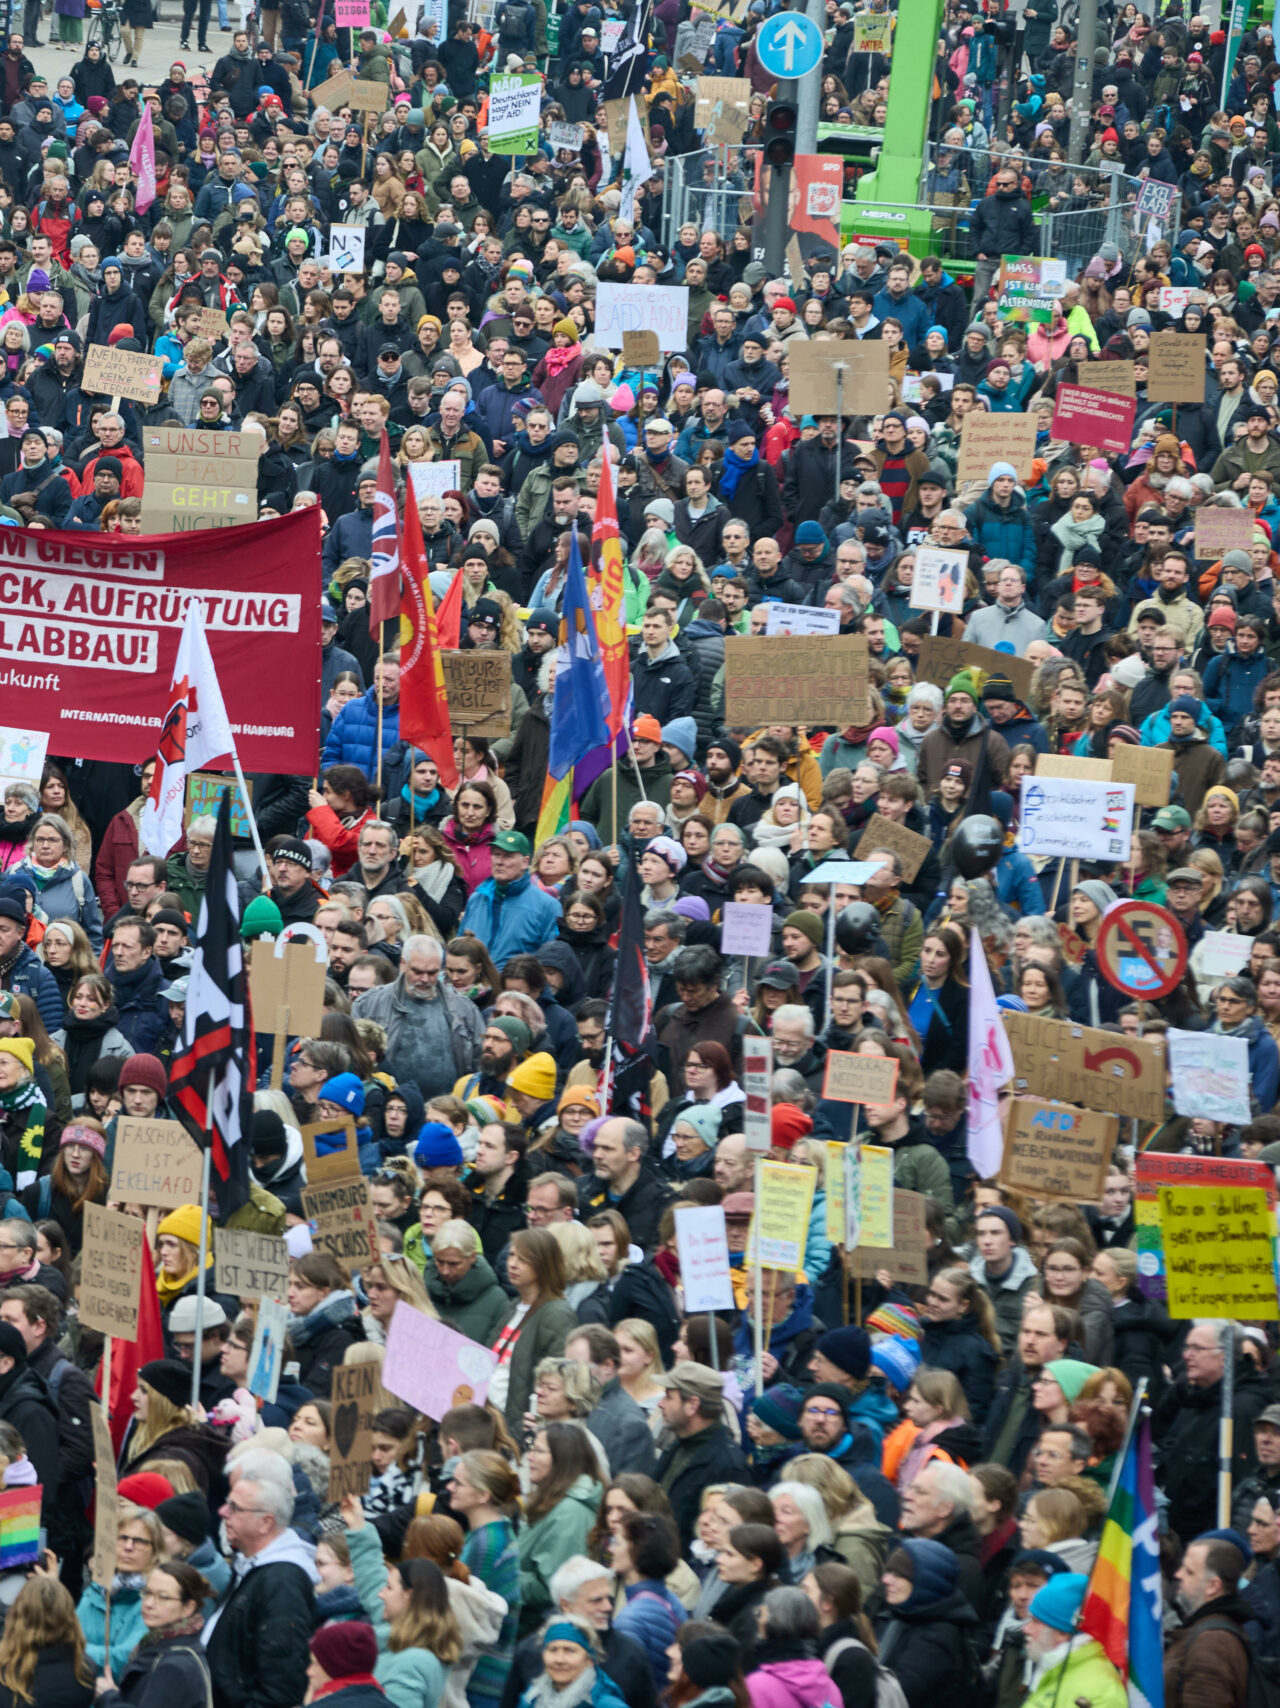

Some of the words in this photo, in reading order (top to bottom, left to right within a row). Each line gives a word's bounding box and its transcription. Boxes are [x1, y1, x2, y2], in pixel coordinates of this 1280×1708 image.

[338, 6, 368, 15] DIGGA
[491, 87, 539, 104] Deutschland
[491, 103, 509, 114] sagt
[511, 99, 531, 109] NEIN
[491, 114, 504, 122] zur
[822, 163, 840, 171] SPD
[1144, 182, 1170, 203] EKEL
[861, 209, 906, 221] MERLO
[1006, 262, 1034, 274] HASS
[1005, 279, 1023, 290] IST
[609, 287, 644, 304] Was
[647, 290, 671, 304] ein
[999, 295, 1053, 311] ALTERNATIVE
[90, 347, 124, 363] NEIN
[128, 353, 161, 369] PATRICK
[99, 371, 134, 384] KEINE
[87, 380, 151, 399] ALTERNATIVE
[1080, 391, 1107, 403] RECHTS
[1063, 395, 1087, 406] WÄHLT
[1087, 399, 1099, 408] DIE
[1062, 403, 1125, 421] MENSCHENRECHTE
[167, 433, 240, 456] UNSER
[172, 487, 231, 508] GEHT
[173, 514, 237, 532] NICHT
[36, 540, 158, 572] GEGEN
[1199, 547, 1225, 559] KEINE
[63, 582, 290, 627] AUFRÜSTUNG
[929, 640, 969, 660] FCK
[442, 658, 504, 681] HAMBURG
[729, 650, 867, 676] DEMOKRATIE
[453, 678, 505, 694] BLEIBT
[729, 675, 867, 698] GERECHTIGKEIT
[729, 698, 868, 722] SOLIDARITÄT
[60, 708, 162, 728] INTERNATIONALER
[243, 725, 295, 738] HAMBURG
[1008, 1014, 1069, 1052] ALICE
[145, 1153, 172, 1169] IST
[1167, 1160, 1206, 1177] ODER
[1208, 1163, 1259, 1182] HEUTE
[1043, 1177, 1073, 1192] OMA
[318, 1183, 368, 1213] HAMBURG
[1165, 1190, 1190, 1216] Ran
[220, 1231, 243, 1258] NIE
[247, 1237, 290, 1266] WIEDER
[221, 1264, 241, 1288] IST
[245, 1267, 289, 1294] JETZT
[335, 1366, 375, 1401] KEIN
